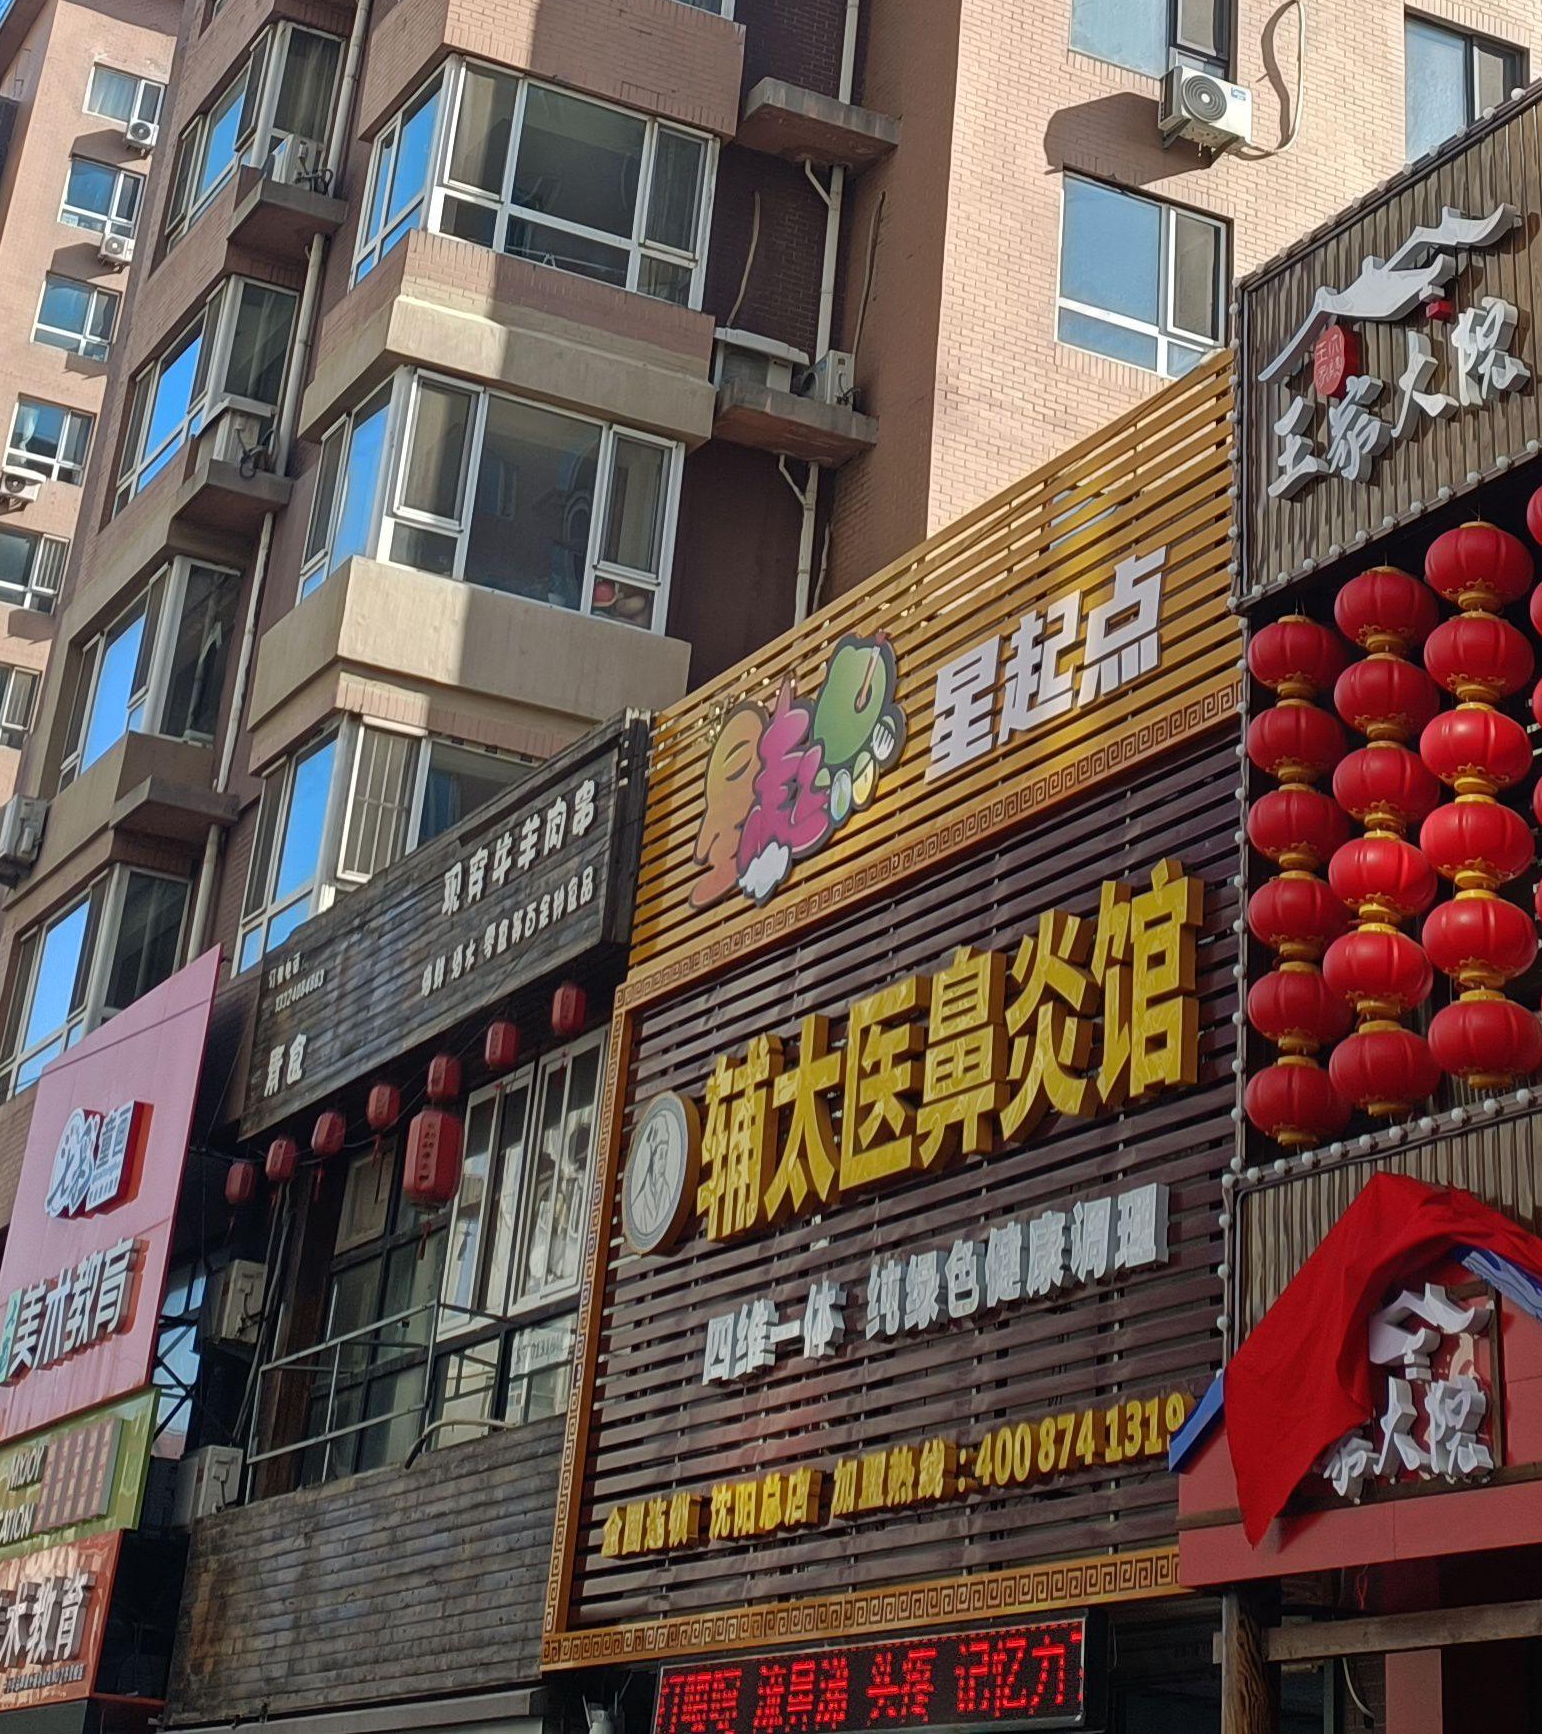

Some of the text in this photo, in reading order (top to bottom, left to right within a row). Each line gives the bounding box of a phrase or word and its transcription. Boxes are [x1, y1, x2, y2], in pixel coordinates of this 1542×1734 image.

[926, 546, 1168, 783] 星起点
[696, 858, 1204, 1241] 辅太医鼻炎馆
[7, 1236, 139, 1379] 美术教育
[701, 1183, 1169, 1386] 四维一体 纯绿色健康调理
[955, 1636, 1067, 1719] 记忆力
